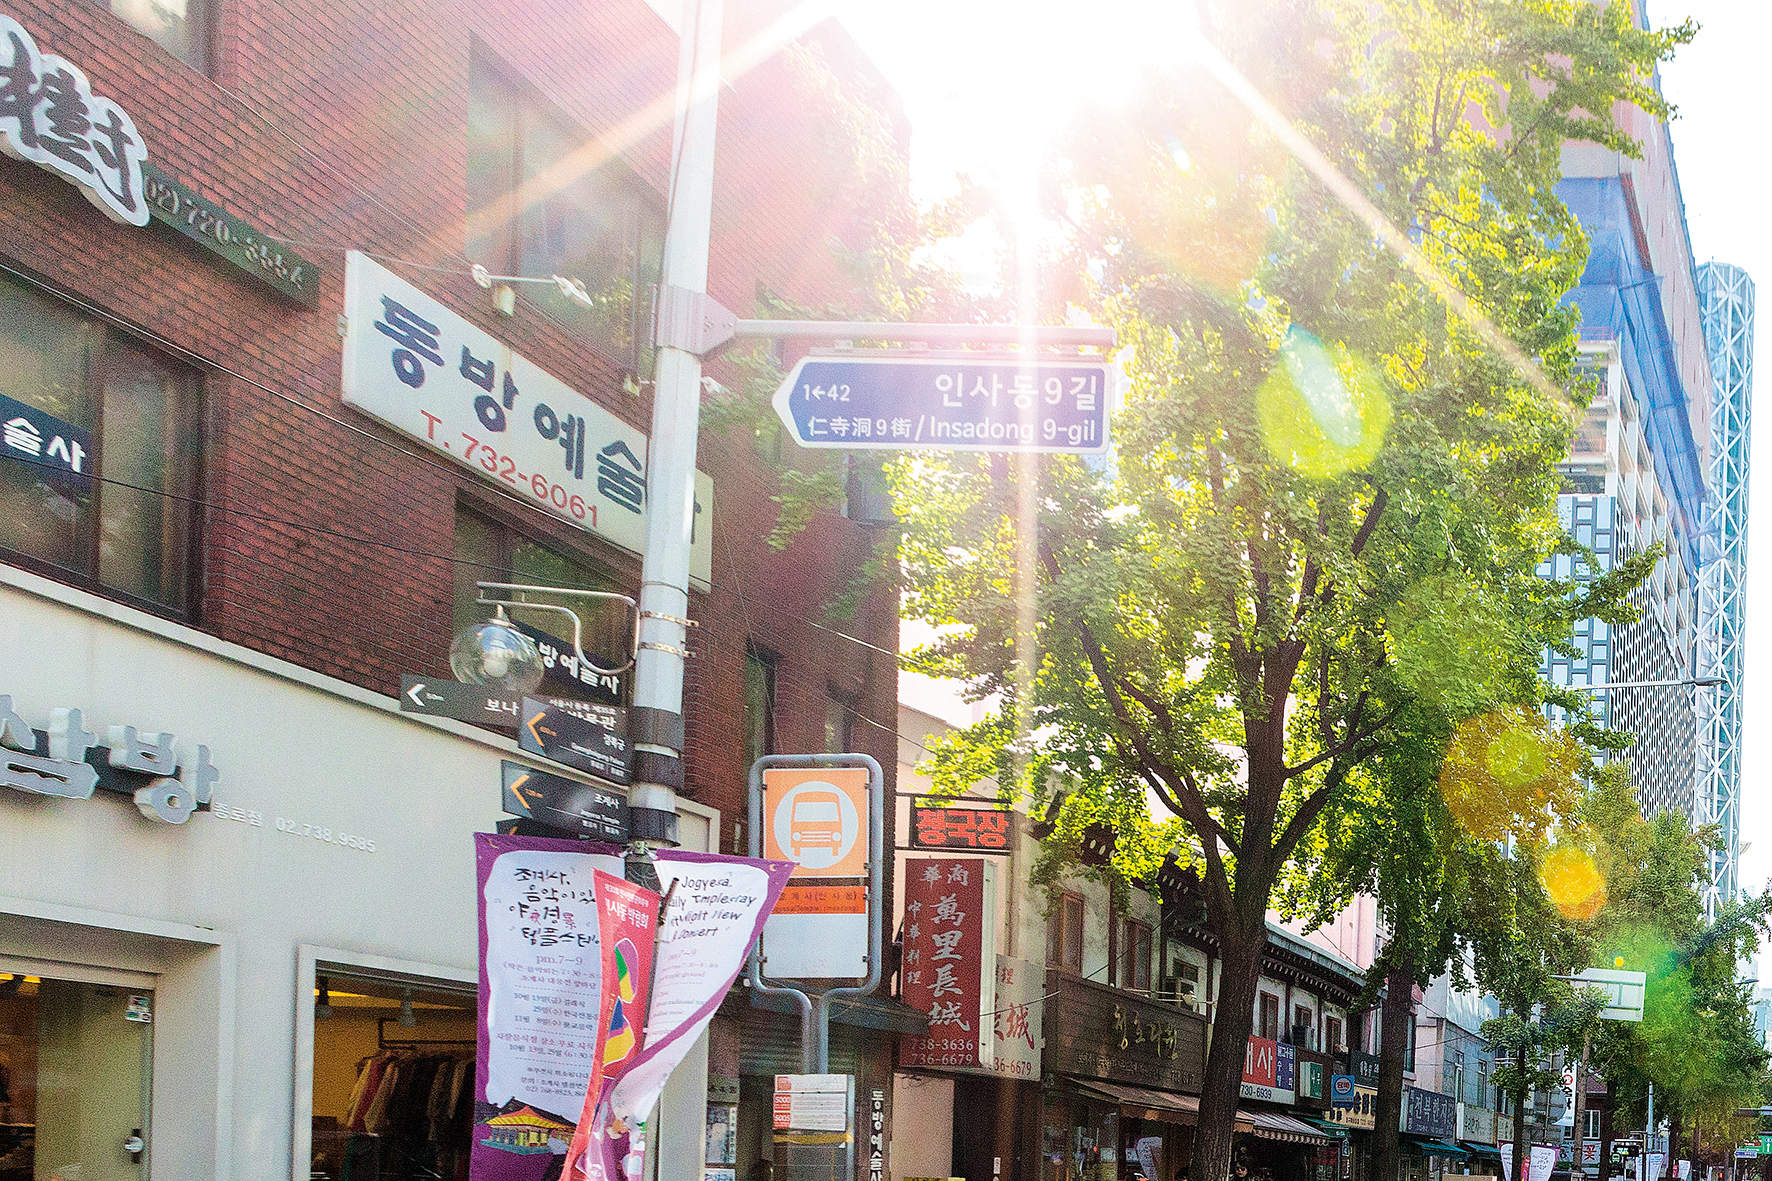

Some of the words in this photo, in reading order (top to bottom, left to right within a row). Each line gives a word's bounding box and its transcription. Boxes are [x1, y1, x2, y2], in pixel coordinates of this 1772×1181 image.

[935, 372, 1098, 411] 인사동9길
[374, 293, 702, 545] 동방예술
[1043, 418, 1096, 446] 9-gil
[3, 417, 87, 473] 술사
[461, 432, 599, 528] 732-6061
[521, 630, 620, 695] 방예술사
[594, 793, 620, 810] 조계사
[276, 816, 377, 853] 02.738.9585
[915, 808, 1010, 848] 청국장
[579, 888, 597, 905] 있
[668, 894, 687, 909] aily
[926, 891, 971, 1032] 萬里長城
[911, 1052, 973, 1066] 736-6679
[994, 1056, 1033, 1076] 36-6679
[1240, 1084, 1273, 1100] 730-6939
